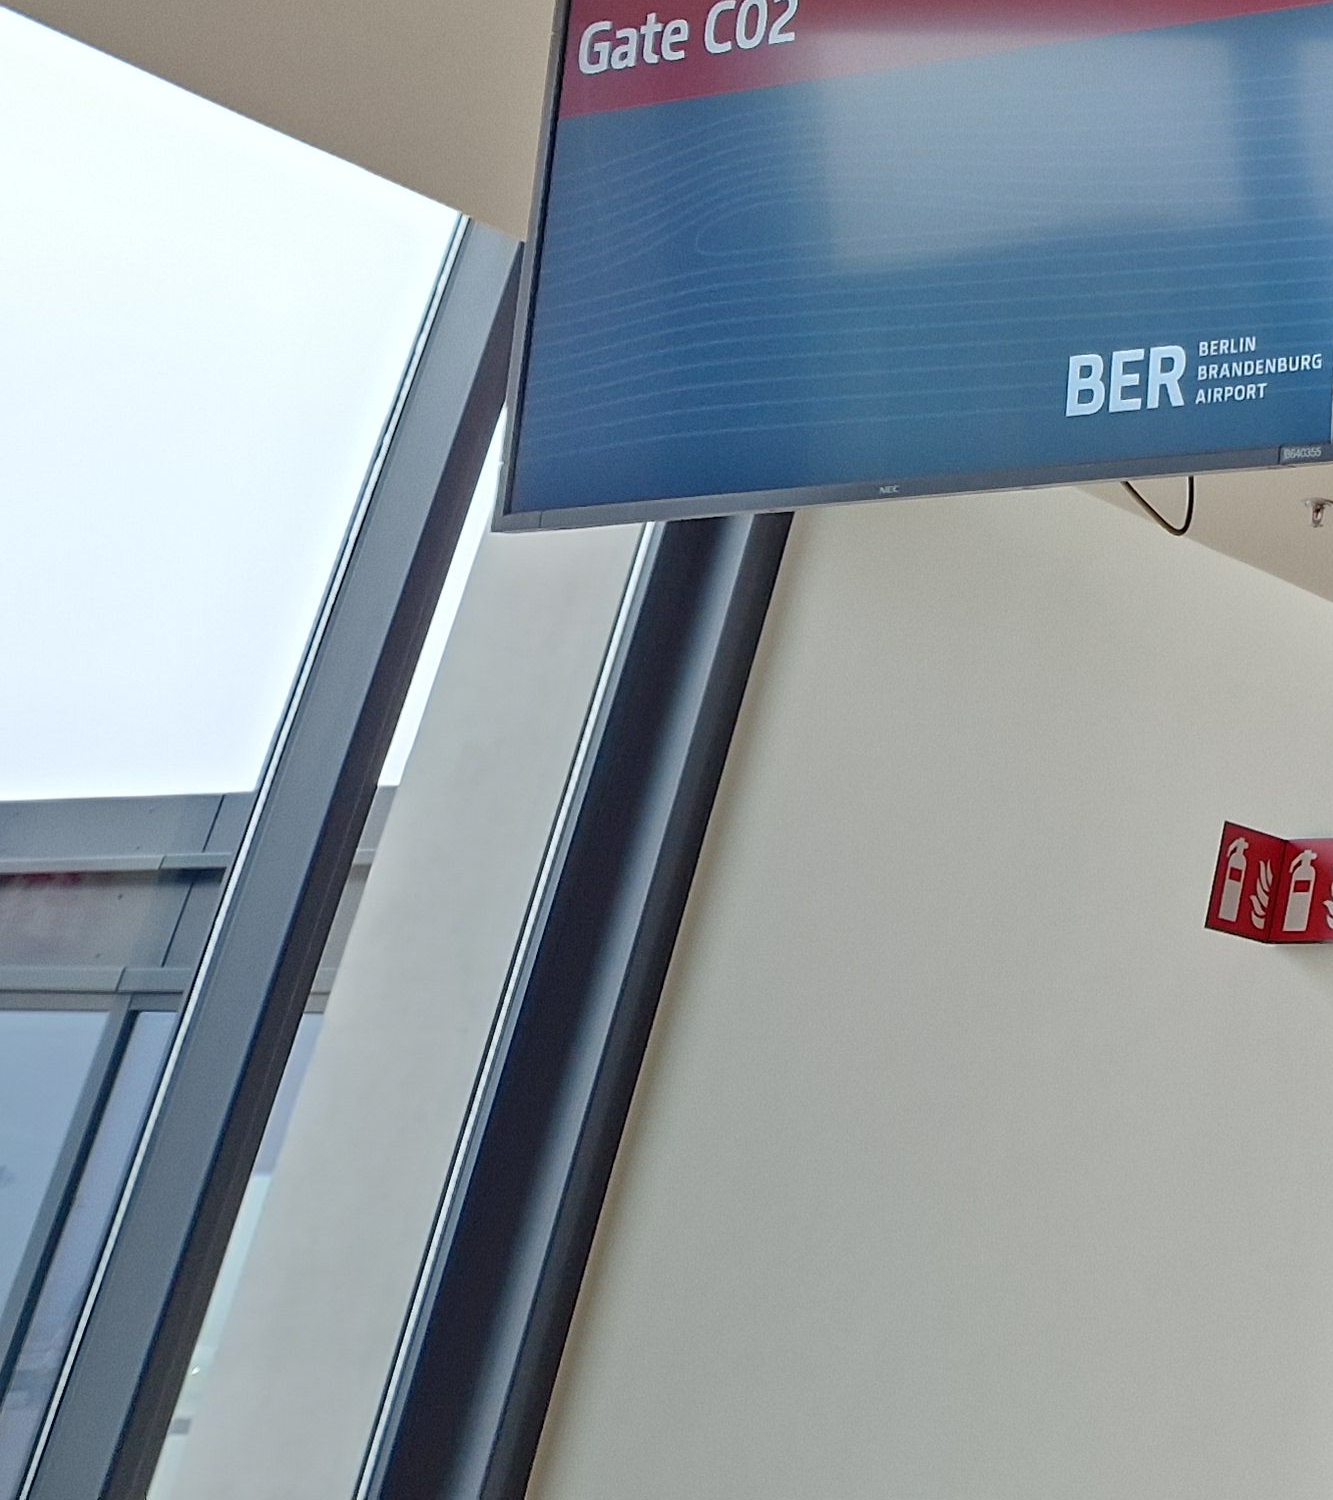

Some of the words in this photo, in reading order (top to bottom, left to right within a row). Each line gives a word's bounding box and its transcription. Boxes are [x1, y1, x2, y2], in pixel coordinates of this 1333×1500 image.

[577, 11, 690, 76] Gate
[1198, 335, 1258, 357] BERLIN
[1065, 344, 1187, 418] BER
[1197, 353, 1323, 381] BRANDENBURG
[1194, 382, 1269, 405] AIRPORT
